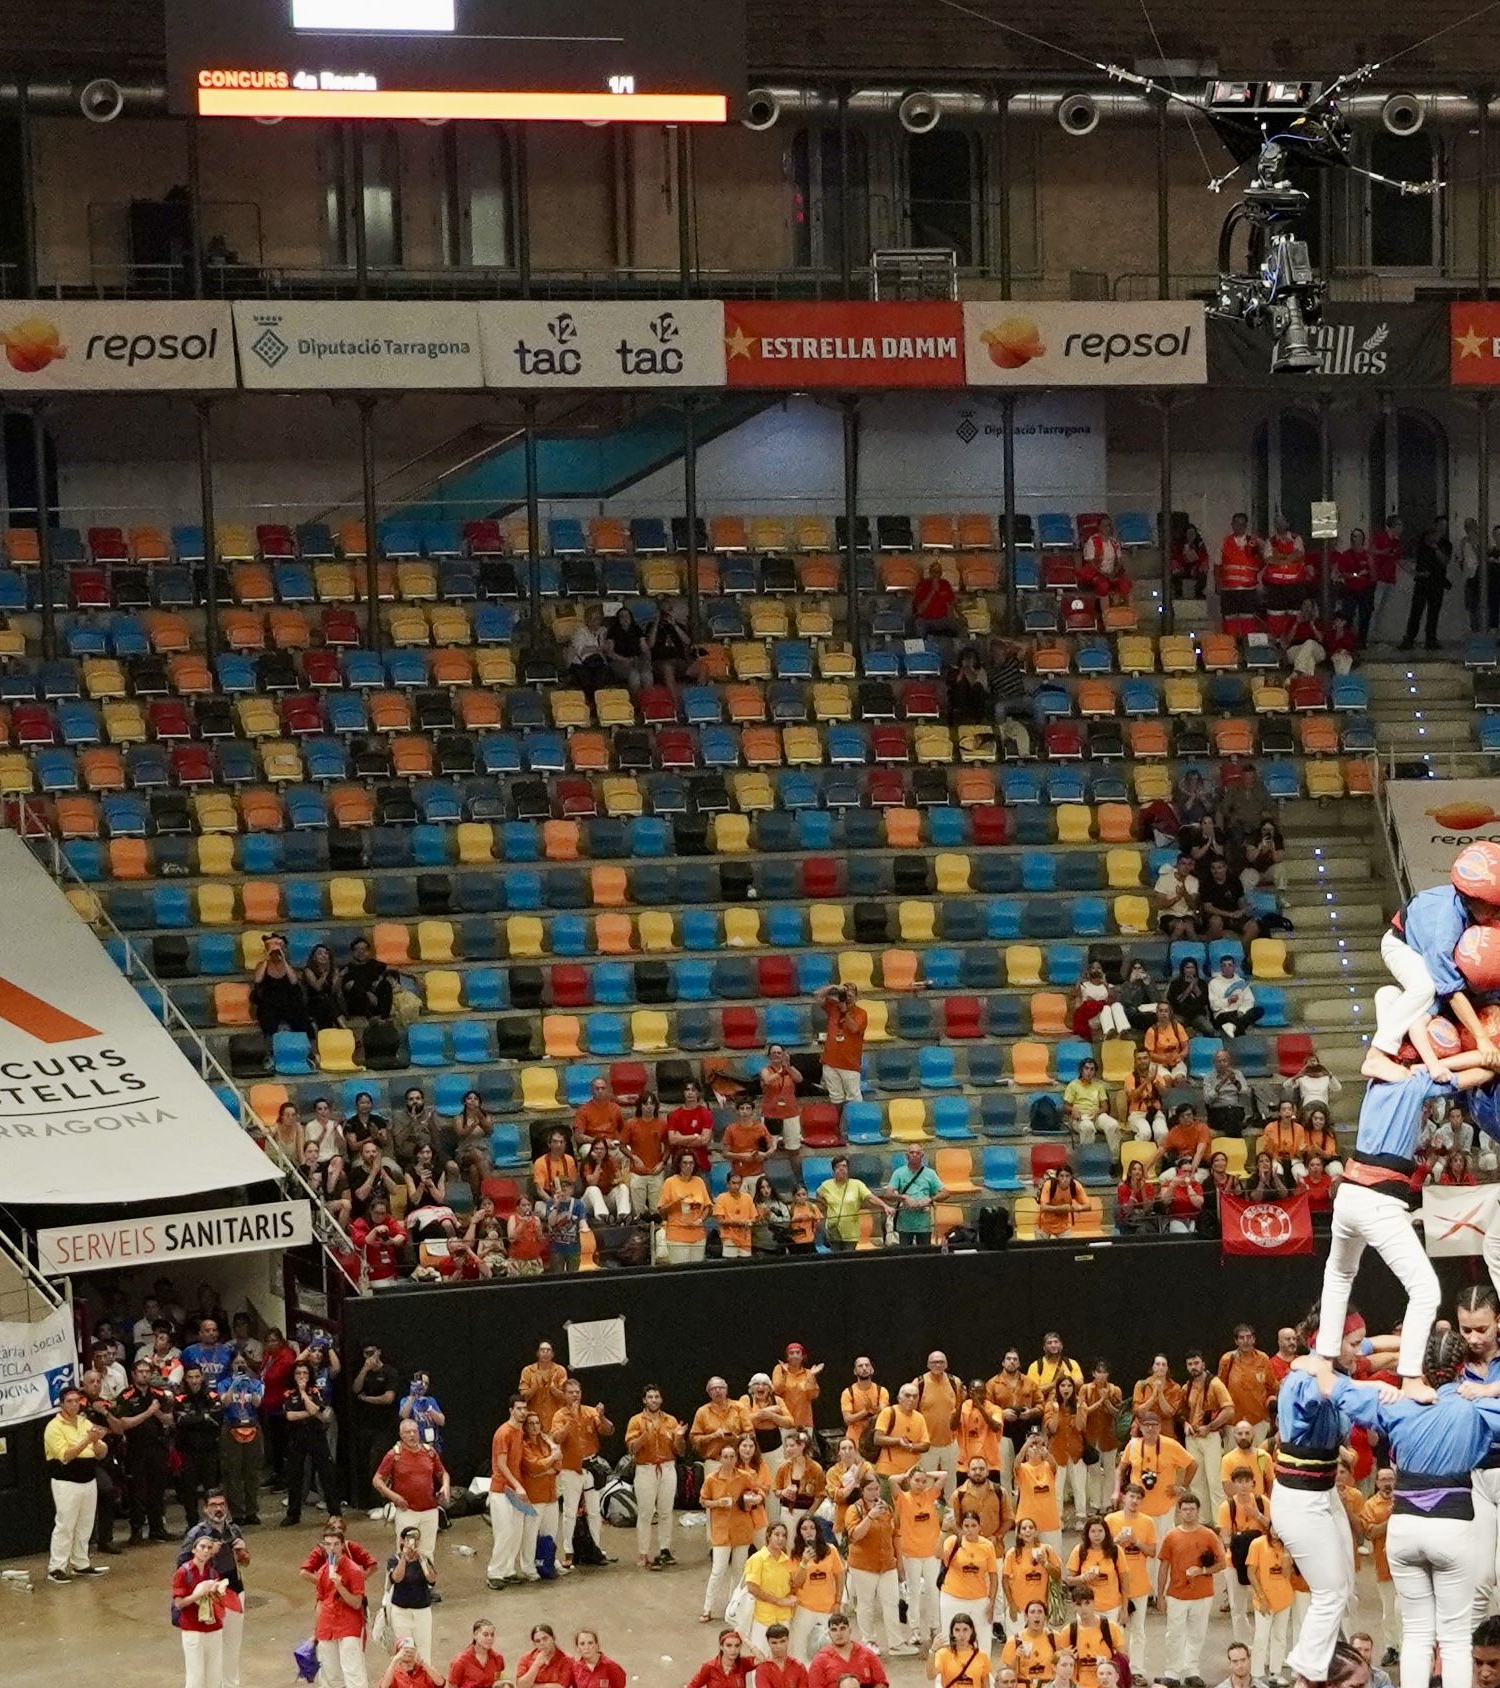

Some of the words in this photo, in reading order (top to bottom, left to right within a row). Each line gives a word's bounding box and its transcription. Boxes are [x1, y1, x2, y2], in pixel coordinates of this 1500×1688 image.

[198, 69, 289, 88] CONCURS
[86, 328, 218, 368] repsol
[298, 336, 381, 360] Diputació
[384, 338, 470, 359] Tarragona
[513, 339, 582, 375] tac
[615, 339, 684, 375] tac
[761, 337, 876, 361] ESTRELLA
[882, 336, 958, 360] DAMM
[1064, 326, 1191, 365] repsol
[984, 424, 1036, 437] Dipació
[1038, 424, 1093, 437] Tarragona
[56, 1226, 156, 1264] SERVEIS
[164, 1210, 295, 1251] SANITARIS
